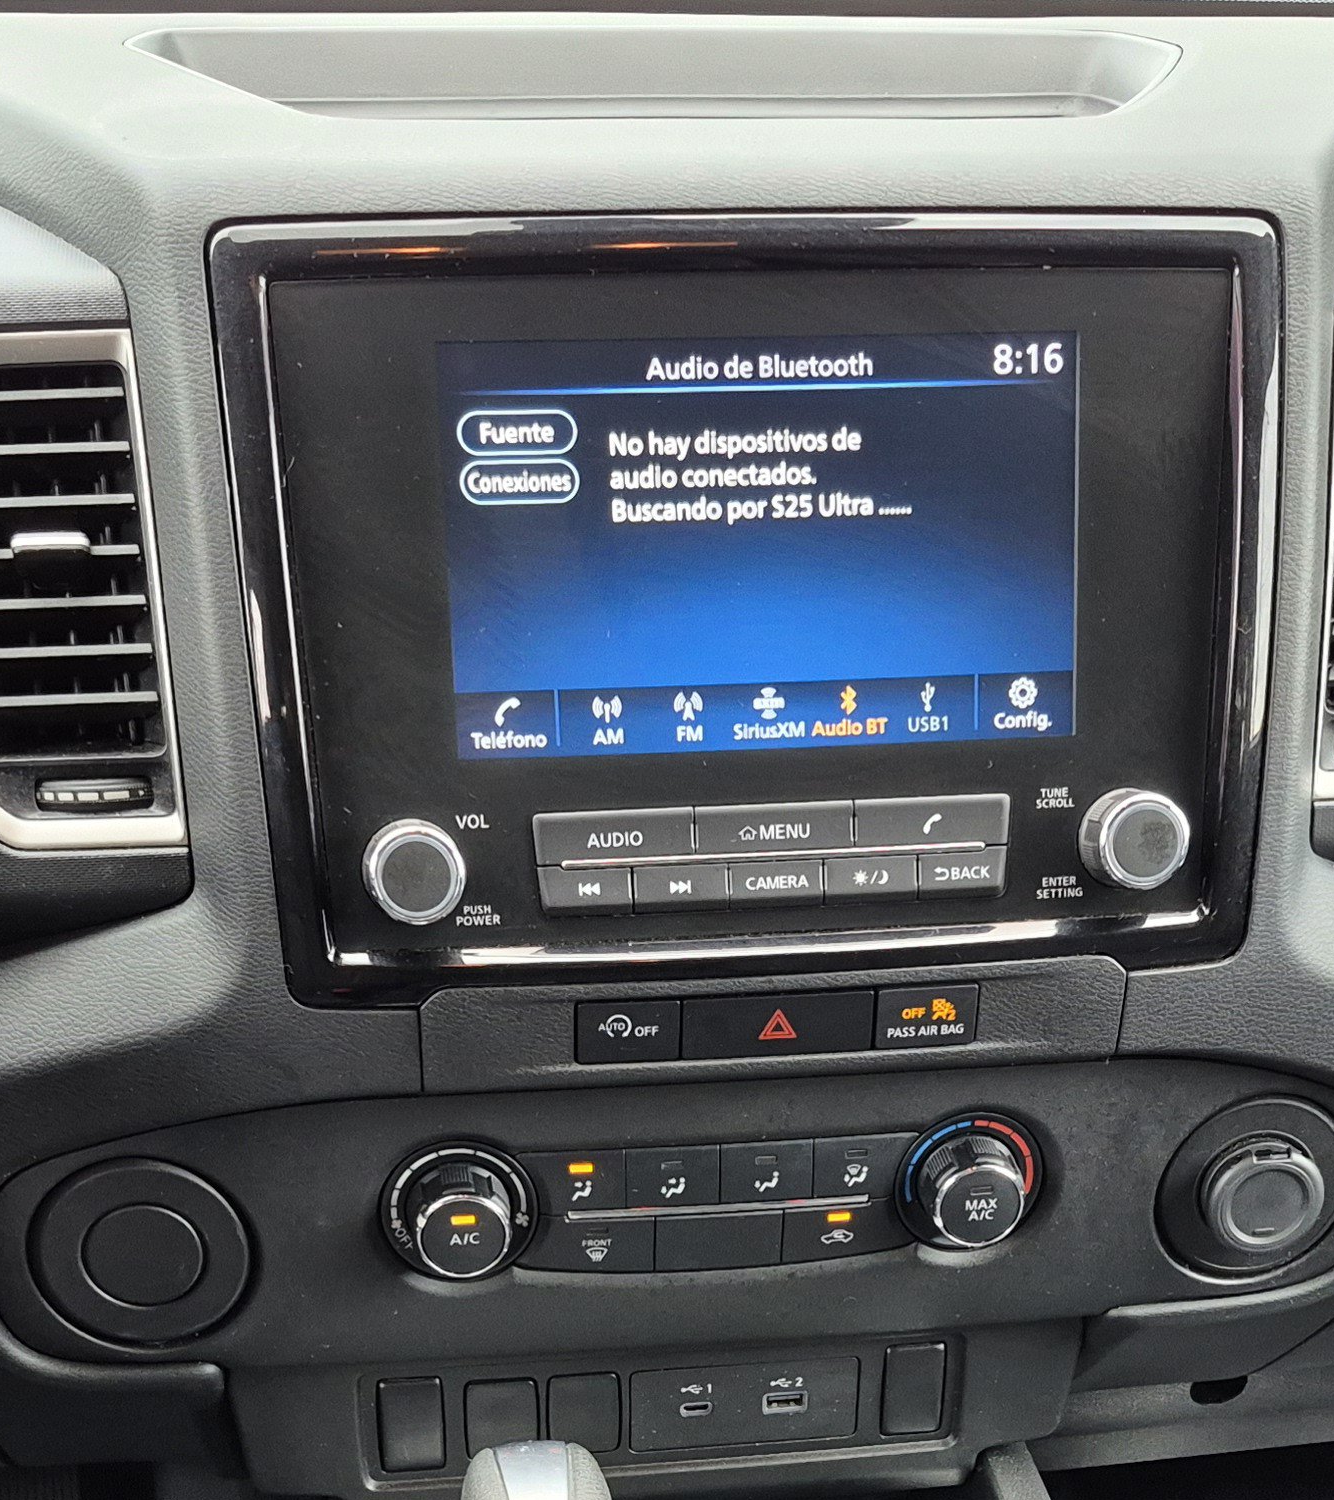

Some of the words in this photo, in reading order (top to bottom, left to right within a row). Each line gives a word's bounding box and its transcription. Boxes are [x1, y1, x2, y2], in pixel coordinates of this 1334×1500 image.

[992, 342, 1064, 374] 8:16
[646, 356, 716, 381] Audio
[724, 356, 753, 380] de
[759, 353, 874, 379] Bluetooth
[479, 421, 555, 445] Fuente
[609, 433, 643, 456] No
[648, 431, 689, 462] hay
[695, 429, 826, 457] dispositivos
[832, 428, 862, 451] de
[467, 472, 572, 494] Conexiones
[610, 465, 677, 489] audio
[682, 464, 817, 488] conectados.
[611, 498, 722, 523] Buscando
[727, 499, 767, 524] por
[772, 494, 813, 519] S25
[818, 494, 873, 516] Ultra
[812, 719, 861, 738] Audio
[866, 717, 887, 735] BT
[908, 713, 949, 733] USB1
[994, 710, 1052, 732] Config.
[593, 725, 625, 746] AM
[677, 722, 703, 742] FM
[733, 721, 805, 740] SiriusXM
[472, 730, 548, 749] Teléfono
[1040, 787, 1069, 798] TUNE
[1036, 798, 1075, 809] SCROLL
[455, 814, 490, 830] VOL
[759, 823, 811, 840] MENU
[587, 830, 643, 849] AUDIO
[950, 866, 990, 879] BACK
[745, 875, 809, 890] CAMERA
[1042, 876, 1076, 887] ENTER
[1036, 887, 1083, 899] SETTING
[463, 905, 491, 915] PUSH
[456, 914, 501, 926] POWER
[901, 1008, 926, 1020] OFF
[634, 1025, 659, 1037] OFF
[887, 1026, 916, 1038] PASS
[918, 1025, 938, 1036] AIR
[940, 1024, 964, 1035] BAG
[965, 1198, 998, 1211] MAX
[968, 1209, 995, 1221] A/C
[449, 1233, 480, 1245] A/C
[582, 1239, 612, 1247] FRONT
[707, 1383, 712, 1393] 1
[795, 1377, 803, 1387] 2
